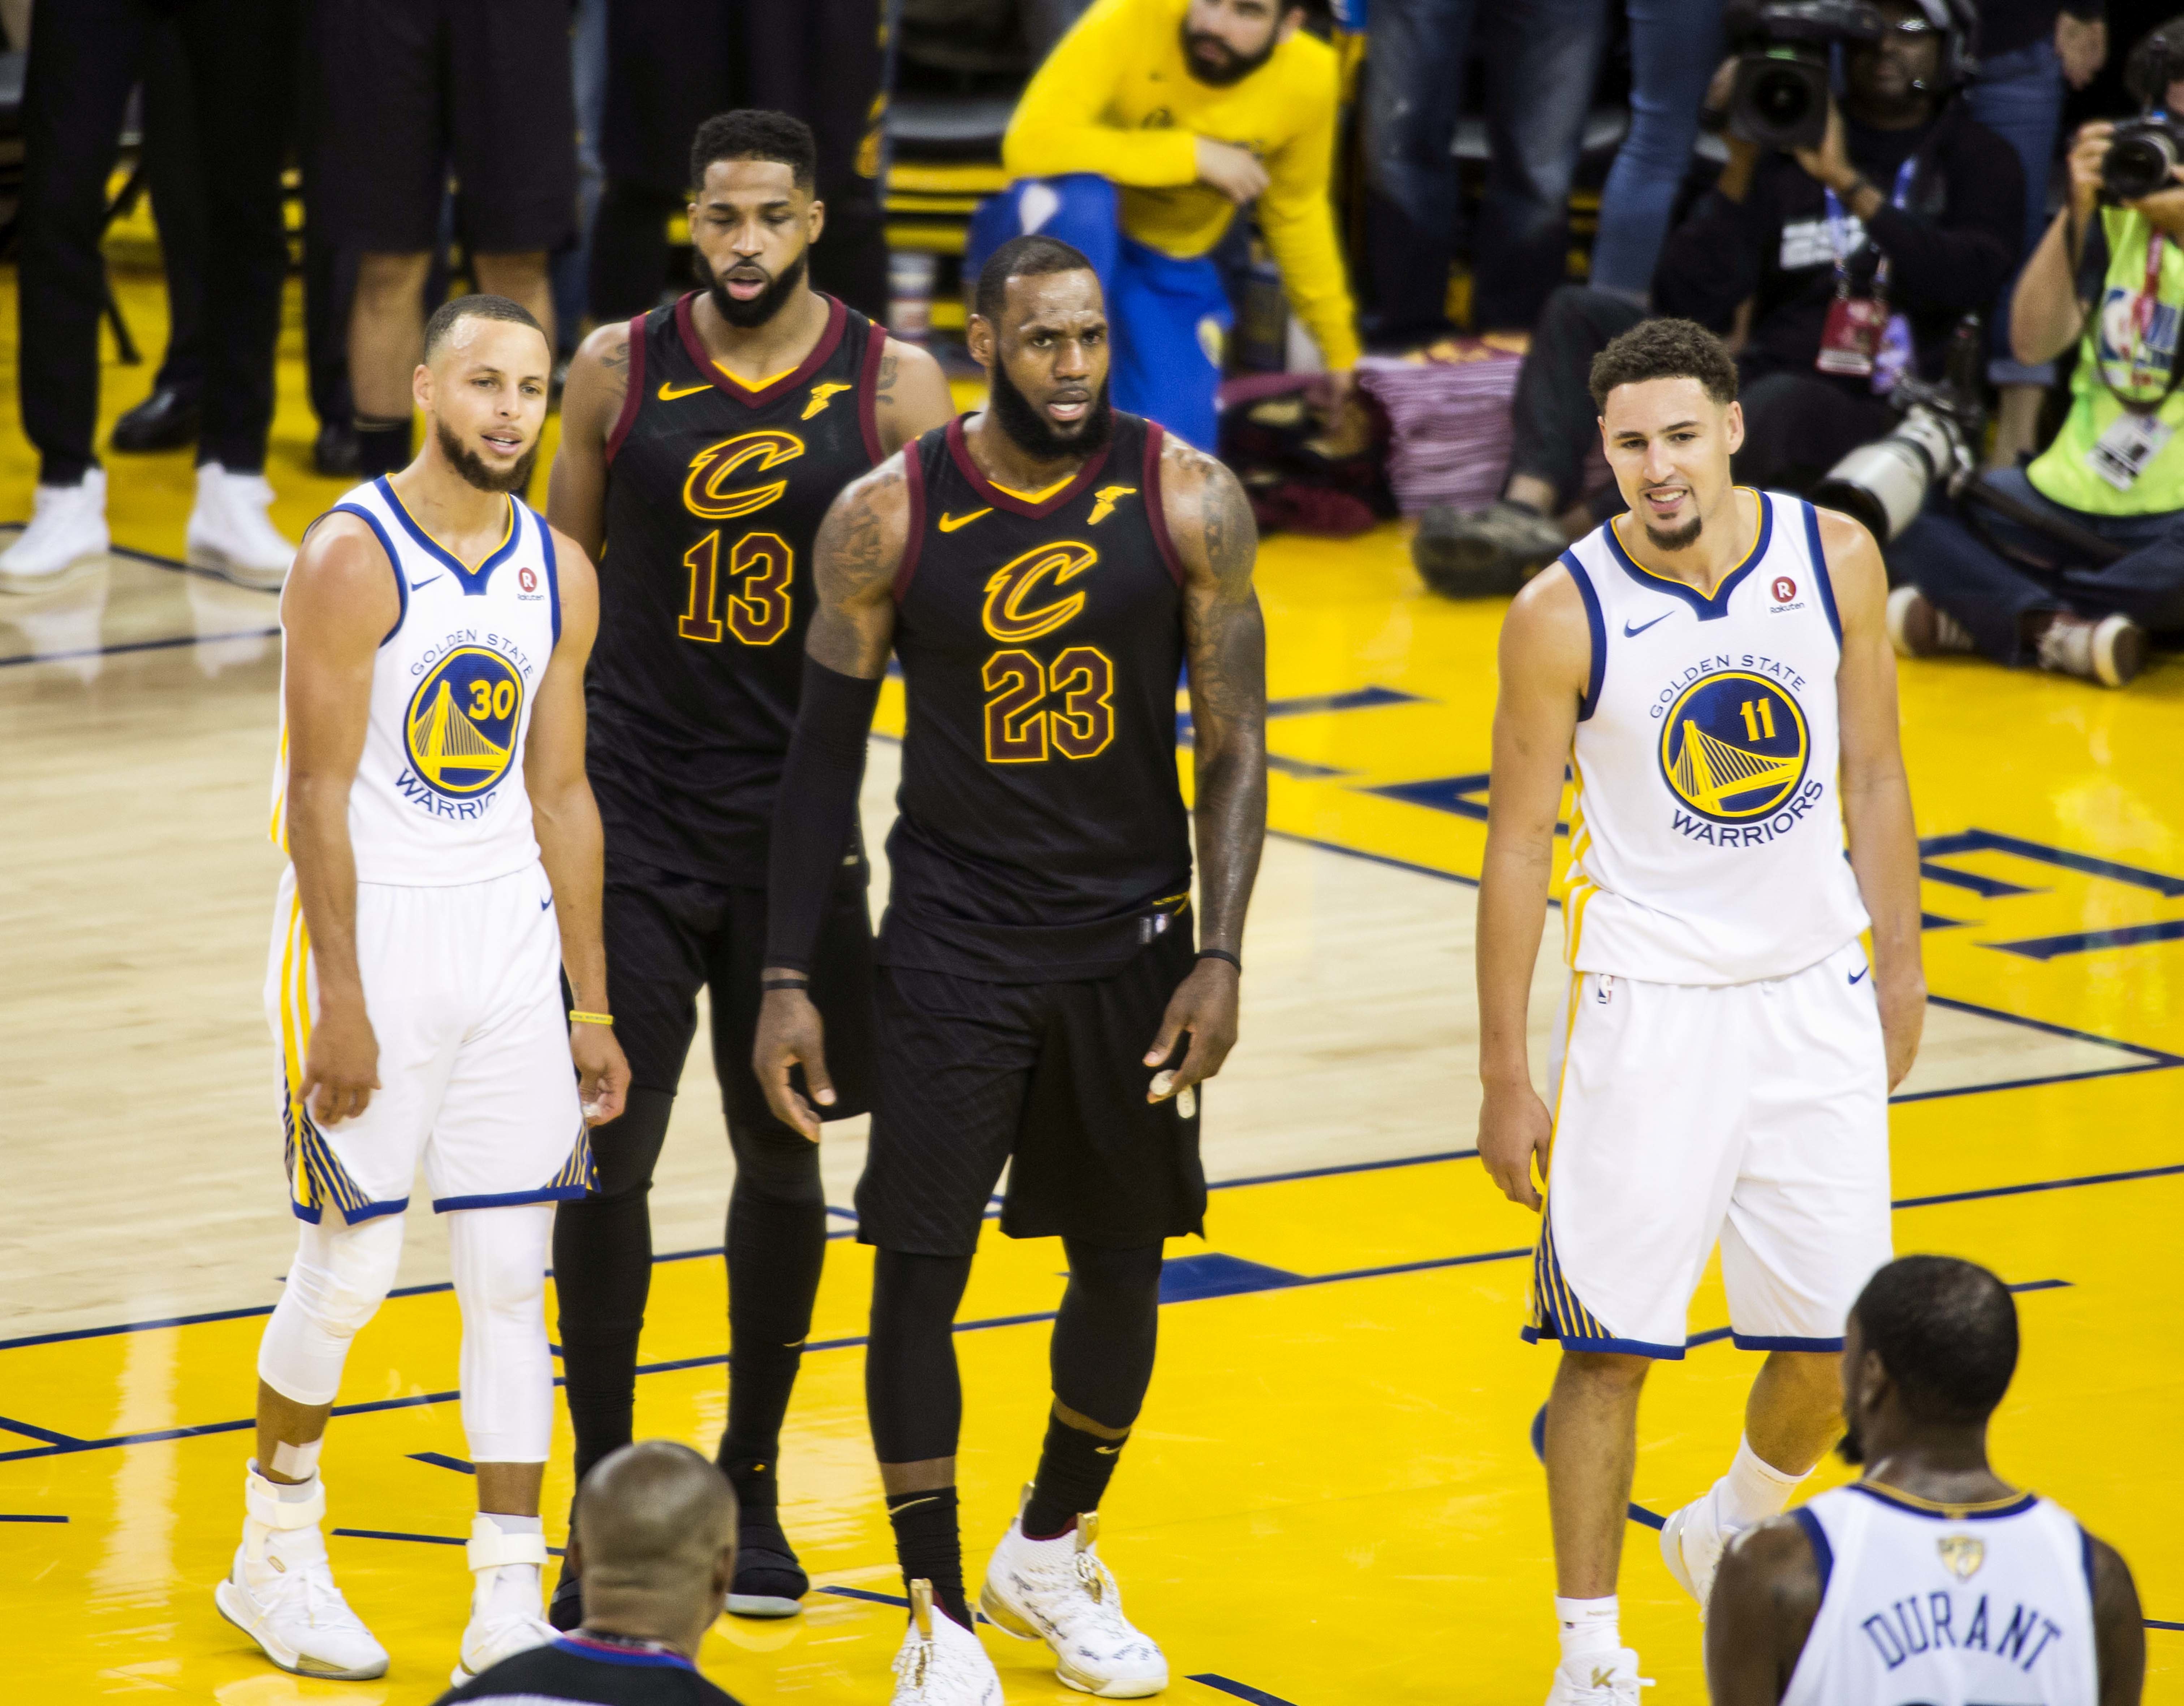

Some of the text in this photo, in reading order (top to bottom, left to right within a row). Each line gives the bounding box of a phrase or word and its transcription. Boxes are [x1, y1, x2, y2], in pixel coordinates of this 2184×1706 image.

[678, 529, 794, 645] 13
[1770, 602, 1805, 614] Rakuten
[410, 629, 533, 679] GOLDEN STATE
[468, 679, 515, 720] 30
[982, 646, 1114, 763] 23
[1650, 654, 1805, 719] GOLDEN STATE
[1739, 698, 1777, 741] 11
[395, 767, 497, 820] WARRI
[1671, 779, 1824, 848] WARRIORS
[1861, 1590, 2063, 1673] DURANT
